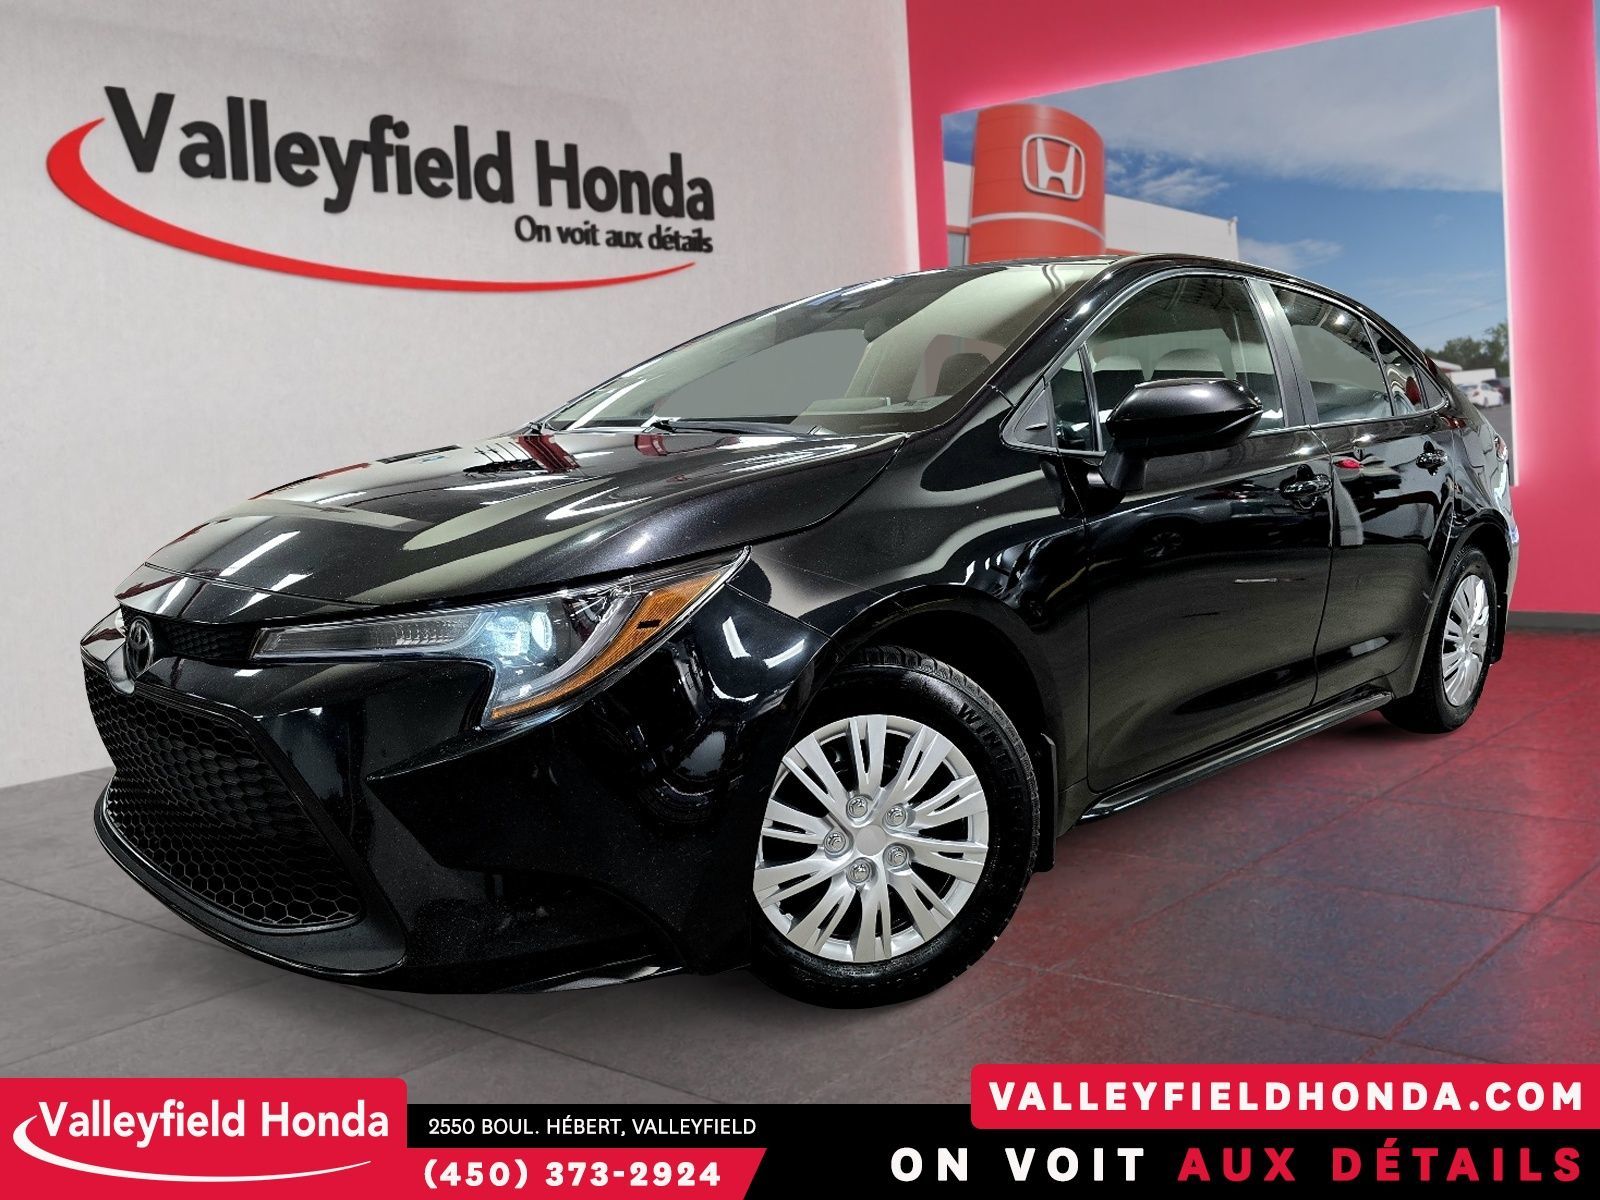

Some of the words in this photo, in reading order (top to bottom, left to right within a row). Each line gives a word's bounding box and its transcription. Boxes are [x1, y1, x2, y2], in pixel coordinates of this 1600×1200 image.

[104, 85, 515, 213] Valleyfield
[534, 139, 715, 221] Honda
[514, 214, 552, 243] On
[556, 219, 600, 247] voit
[605, 229, 644, 249] aux
[647, 223, 714, 254] détails
